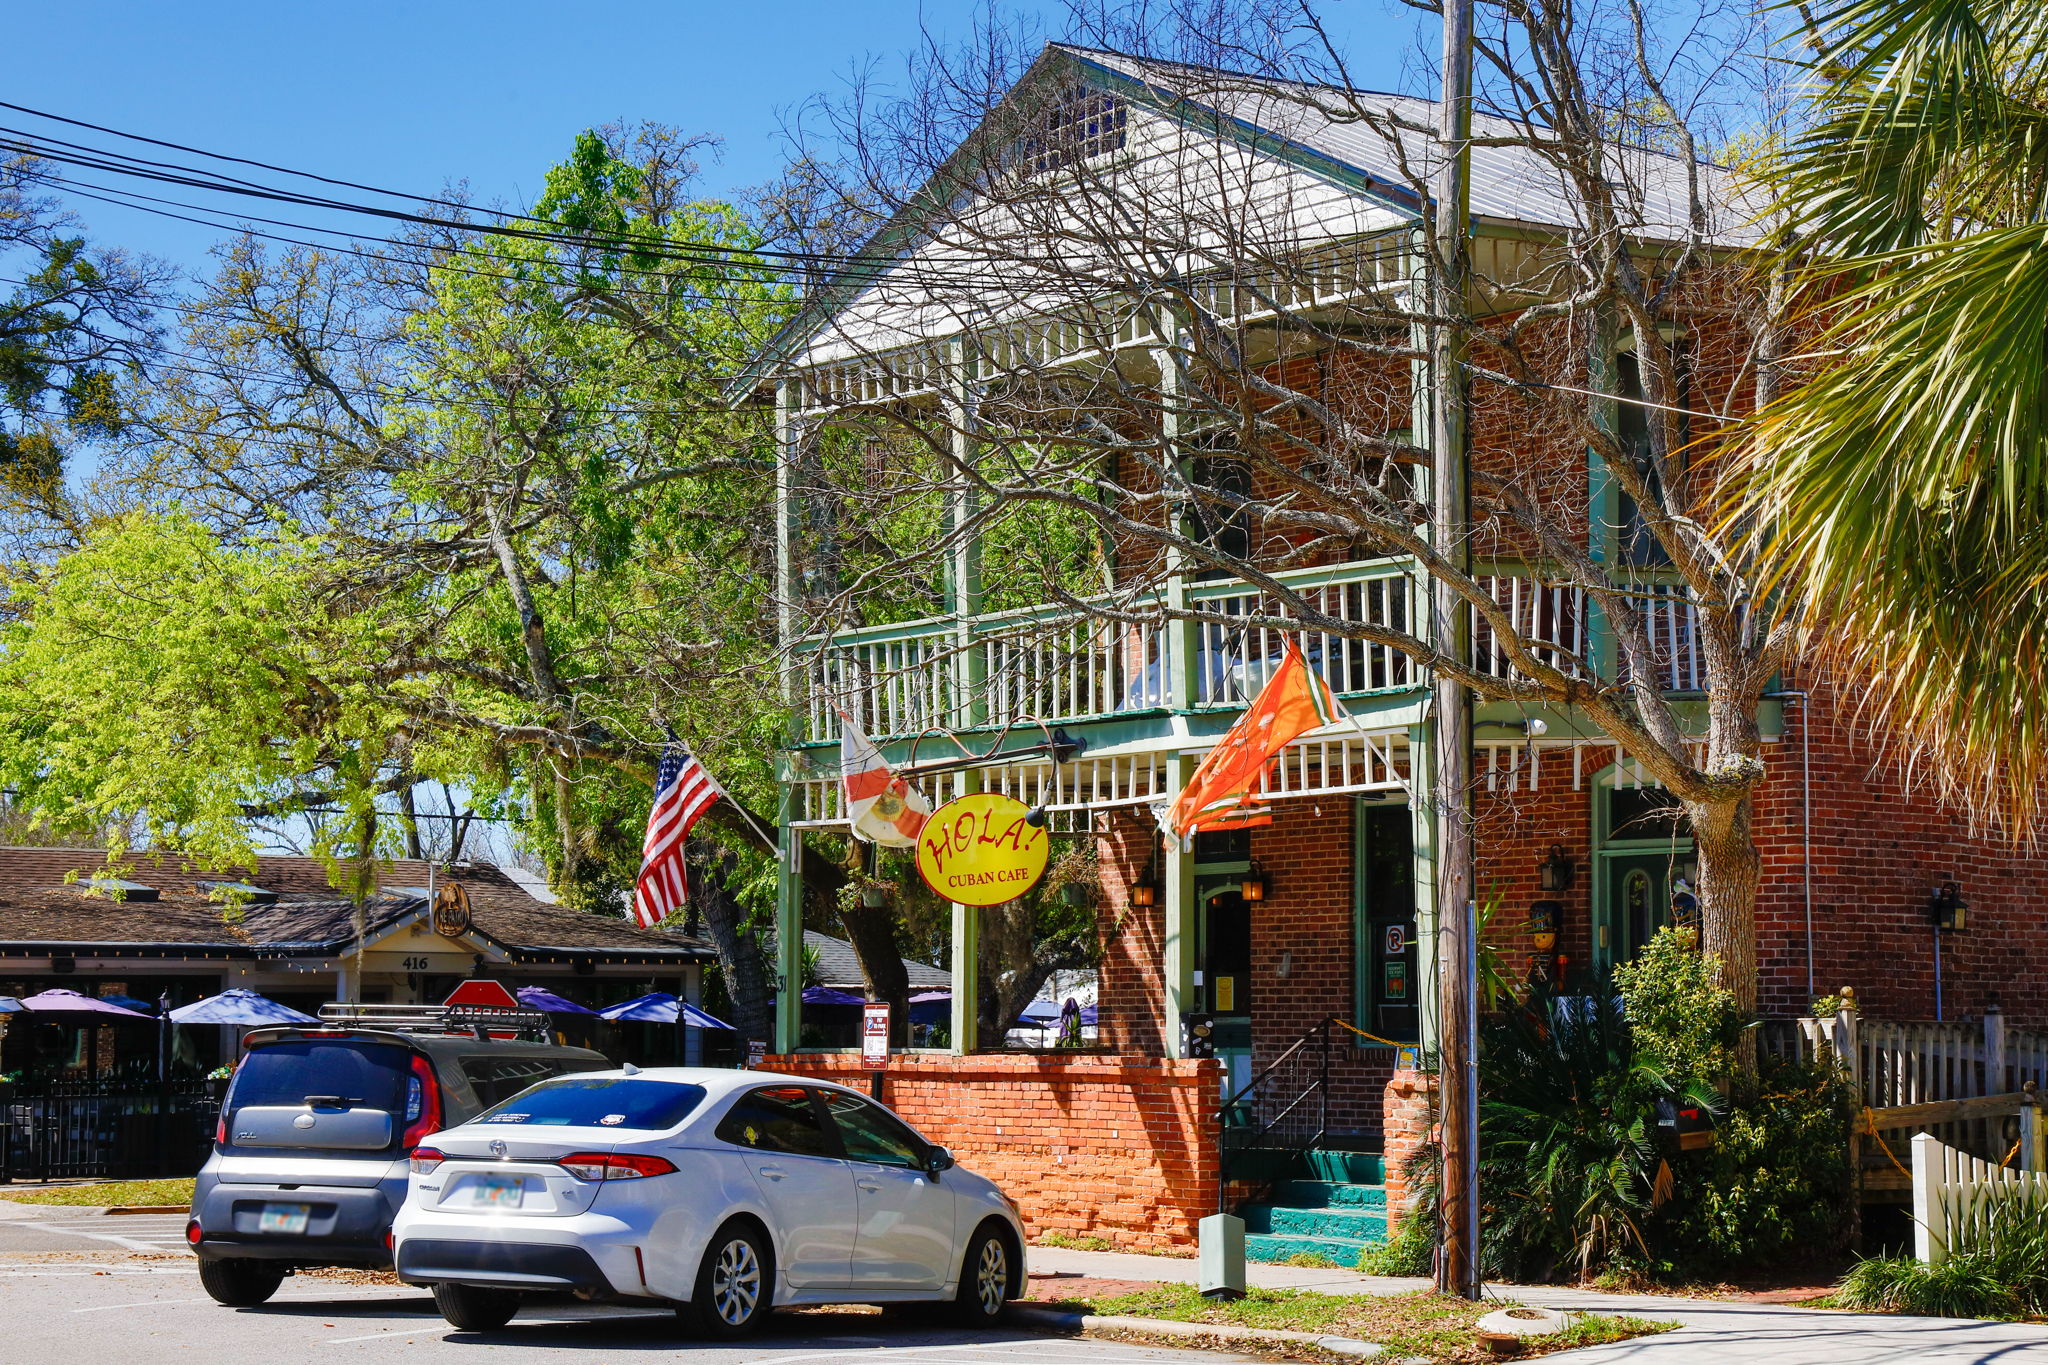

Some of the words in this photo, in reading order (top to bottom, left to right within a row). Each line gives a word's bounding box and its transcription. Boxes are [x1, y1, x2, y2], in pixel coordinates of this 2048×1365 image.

[926, 808, 1042, 874] HOLA!
[948, 871, 995, 888] CUBAN
[997, 867, 1030, 883] CAFE
[402, 956, 429, 970] 416
[776, 975, 787, 993] 31
